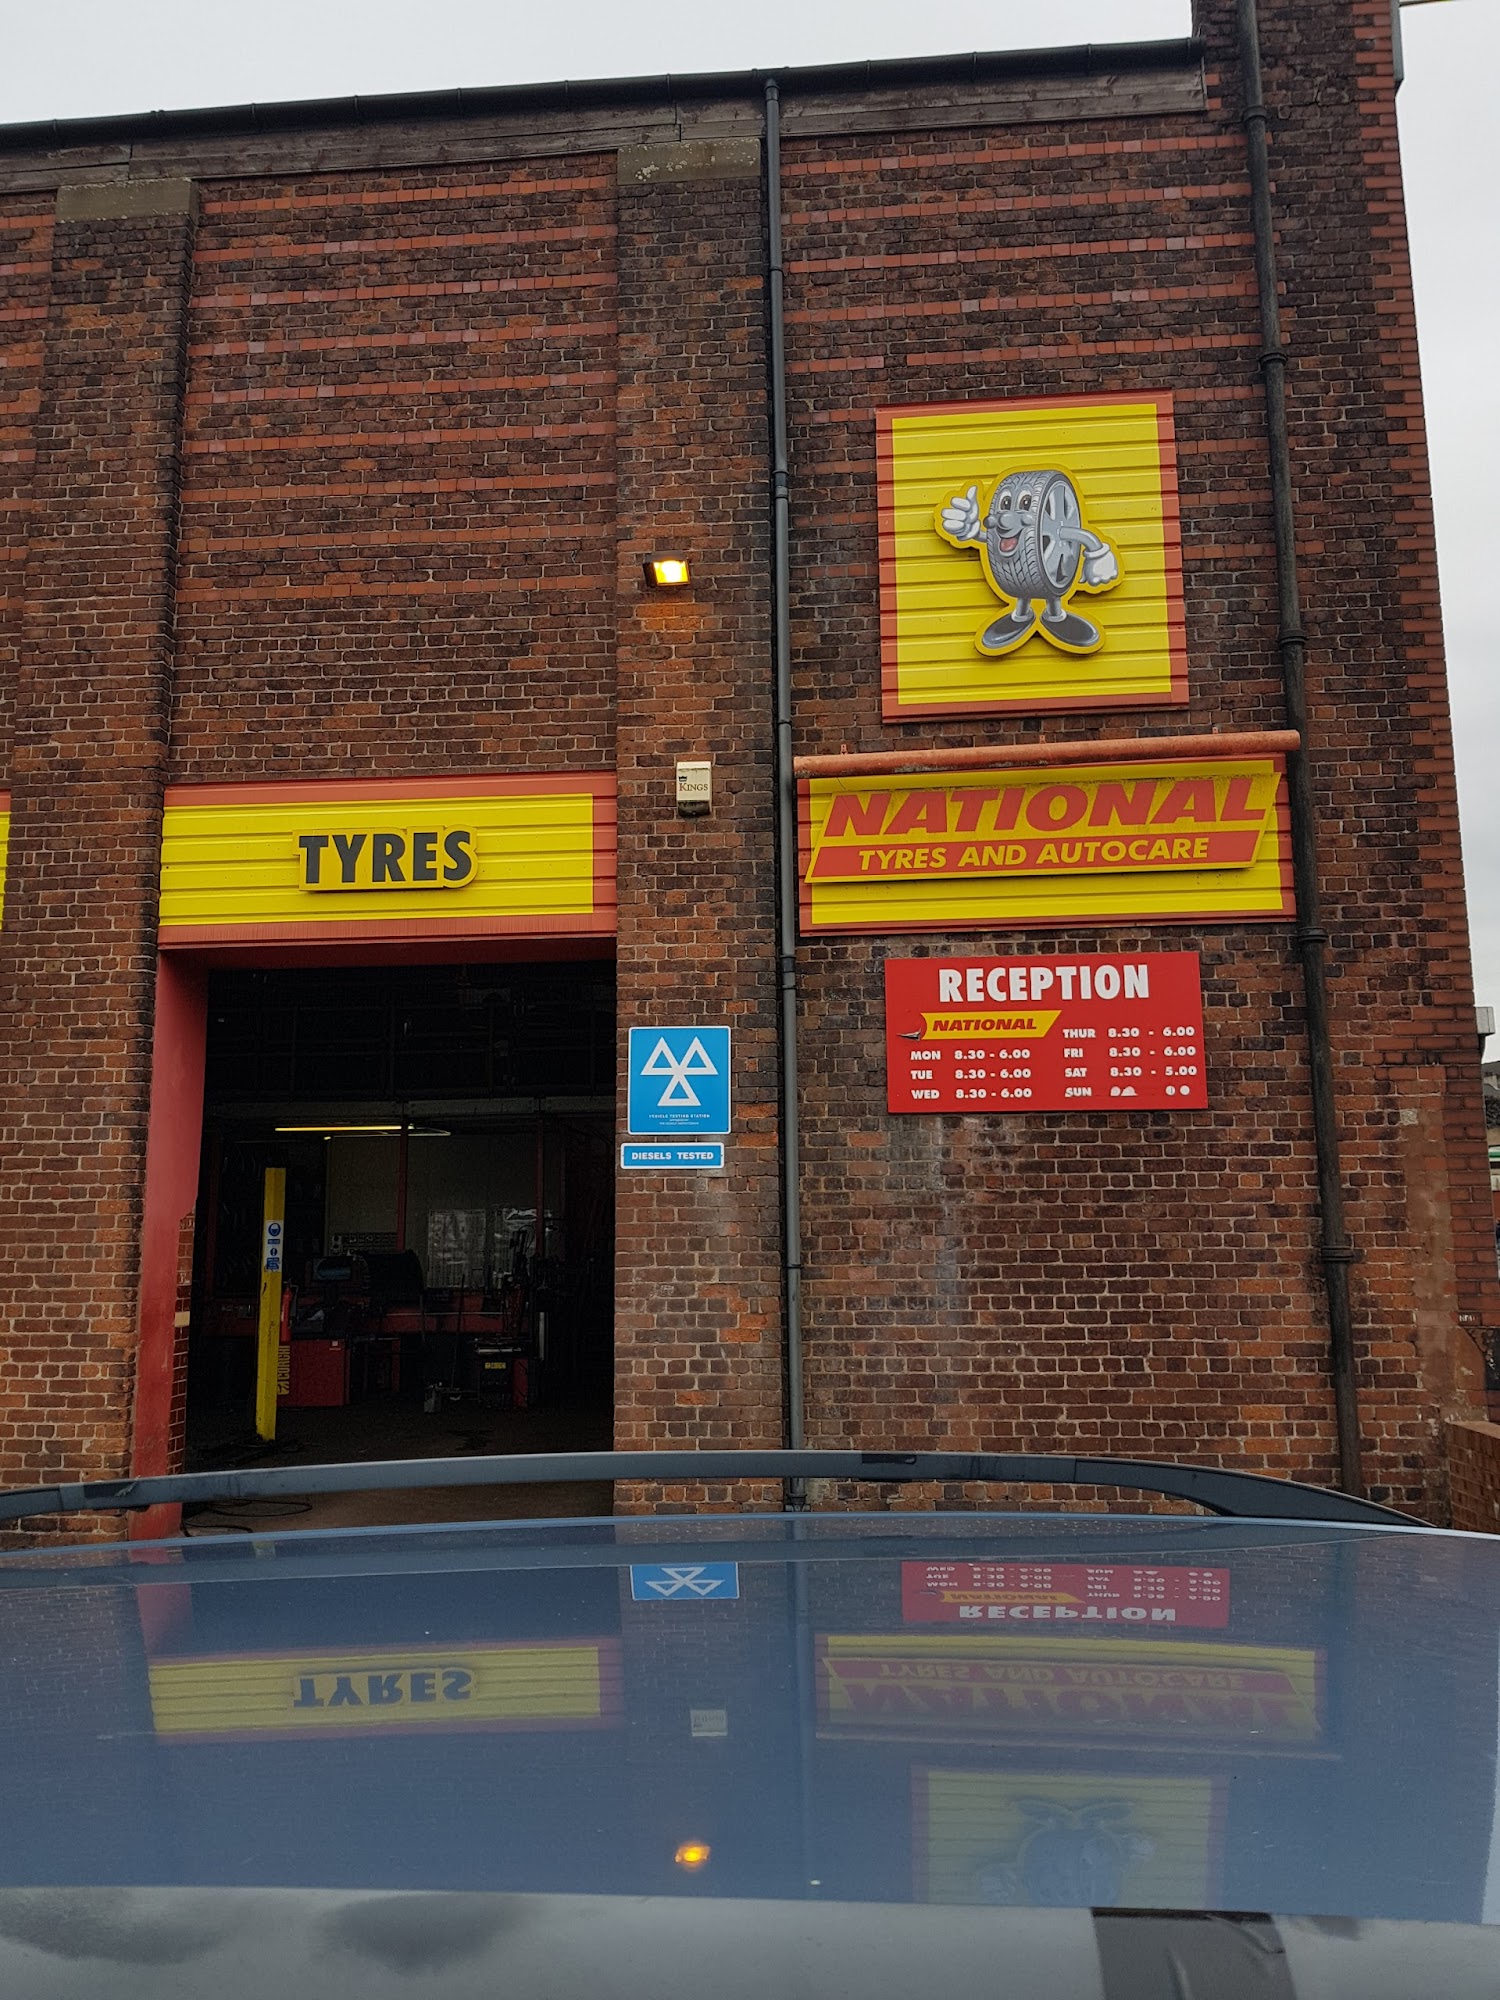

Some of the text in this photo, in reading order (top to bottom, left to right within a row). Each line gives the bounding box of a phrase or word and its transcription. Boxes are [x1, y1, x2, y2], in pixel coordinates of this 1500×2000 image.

[823, 778, 1267, 837] NATIONAL
[299, 830, 472, 885] TYRES
[858, 837, 1208, 871] TYRES AND AUTOCARE
[938, 964, 1150, 1003] RECEPTION
[932, 1018, 1037, 1031] NATIONAL
[1062, 1028, 1096, 1038] THUR
[1107, 1027, 1140, 1038] 8.30
[1162, 1026, 1195, 1037] 6.00
[910, 1050, 941, 1060] MON
[954, 1049, 986, 1060] 8.30
[999, 1048, 1031, 1059] 6.00
[1063, 1048, 1083, 1058] FRI
[1109, 1047, 1141, 1057] 8.30
[1163, 1046, 1196, 1056] 6.00
[910, 1070, 933, 1080] TUE
[954, 1068, 986, 1079] 8.30
[1000, 1068, 1032, 1079] 6.00
[1064, 1067, 1088, 1078] SAT
[1110, 1066, 1142, 1077] 8.30
[1165, 1065, 1198, 1076] 5.00
[911, 1089, 940, 1099] WED
[955, 1088, 987, 1099] 8.30
[1000, 1087, 1033, 1098] 6.00
[1064, 1087, 1093, 1097] SUN
[632, 1151, 714, 1160] DIESELS TESTED
